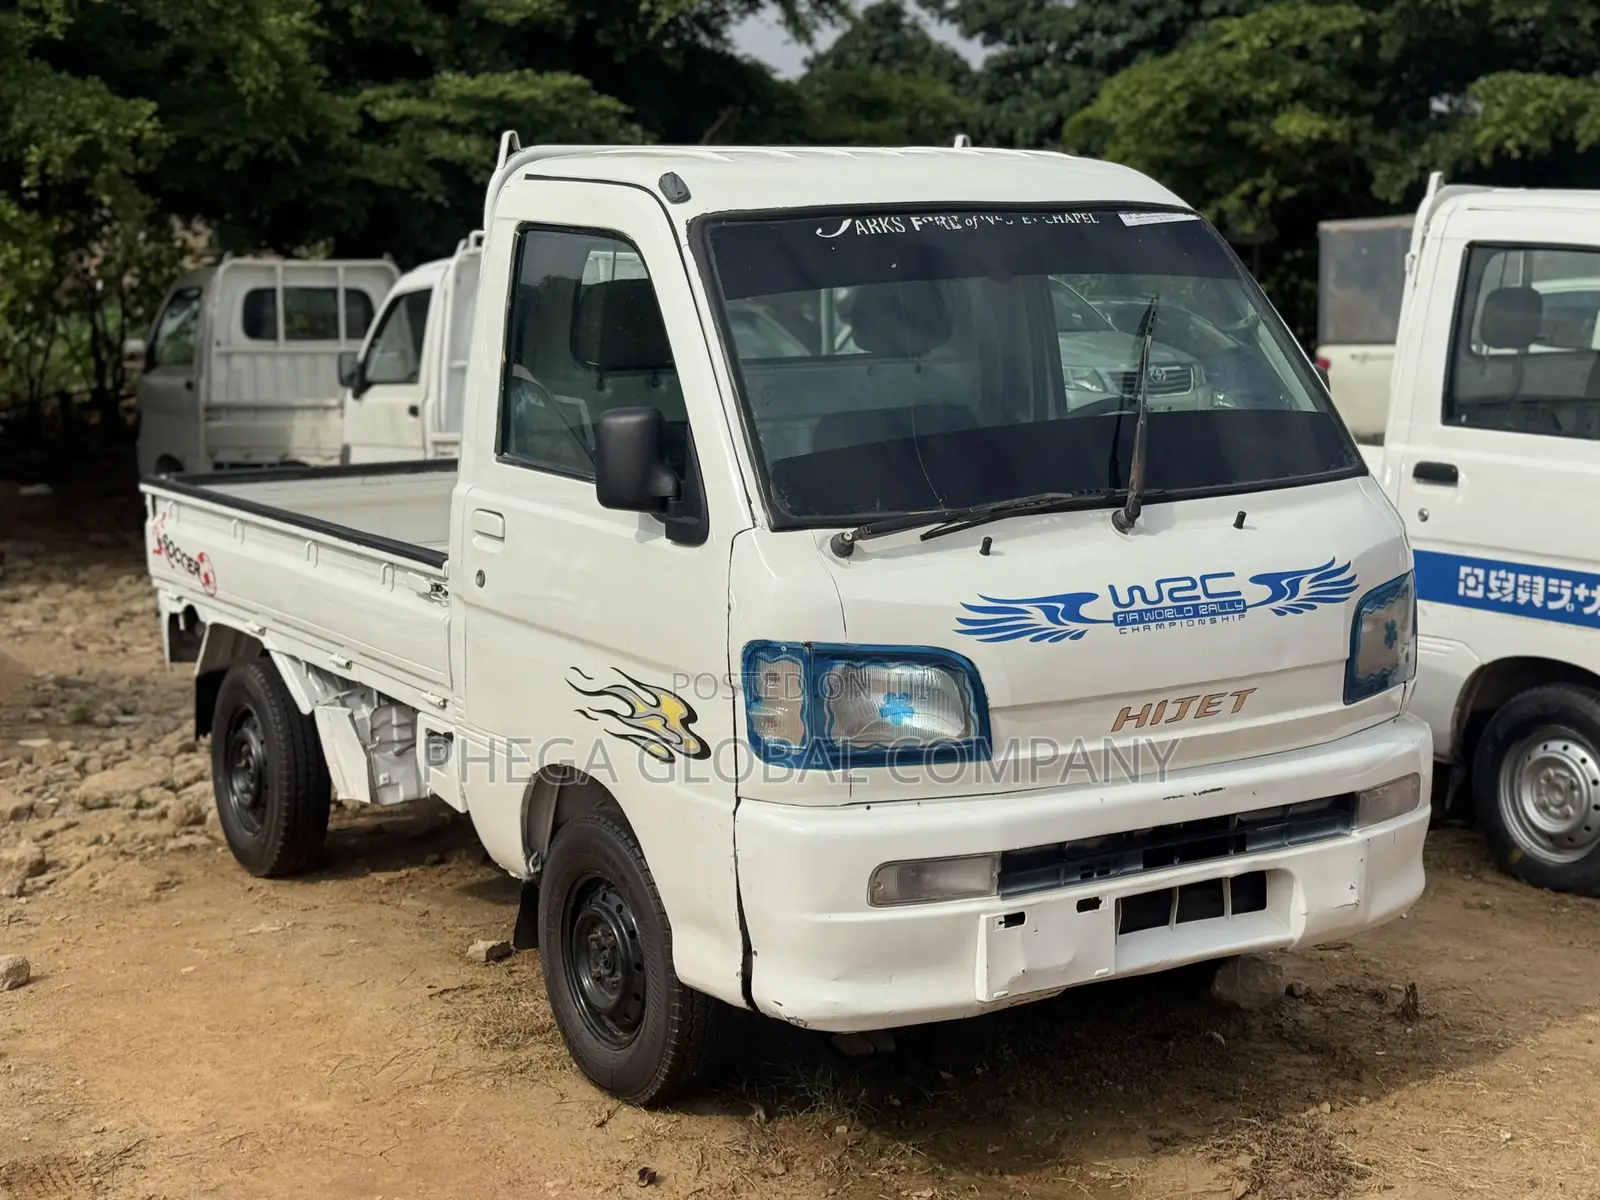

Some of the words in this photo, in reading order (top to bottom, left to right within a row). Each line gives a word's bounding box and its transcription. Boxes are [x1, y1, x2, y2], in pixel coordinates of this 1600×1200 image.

[1116, 612, 1139, 625] FIA
[1142, 606, 1194, 622] WORLD
[1198, 600, 1245, 616] RALLY
[1118, 613, 1247, 635] CHAMPIONSHIP
[1111, 687, 1259, 733] HIJET
